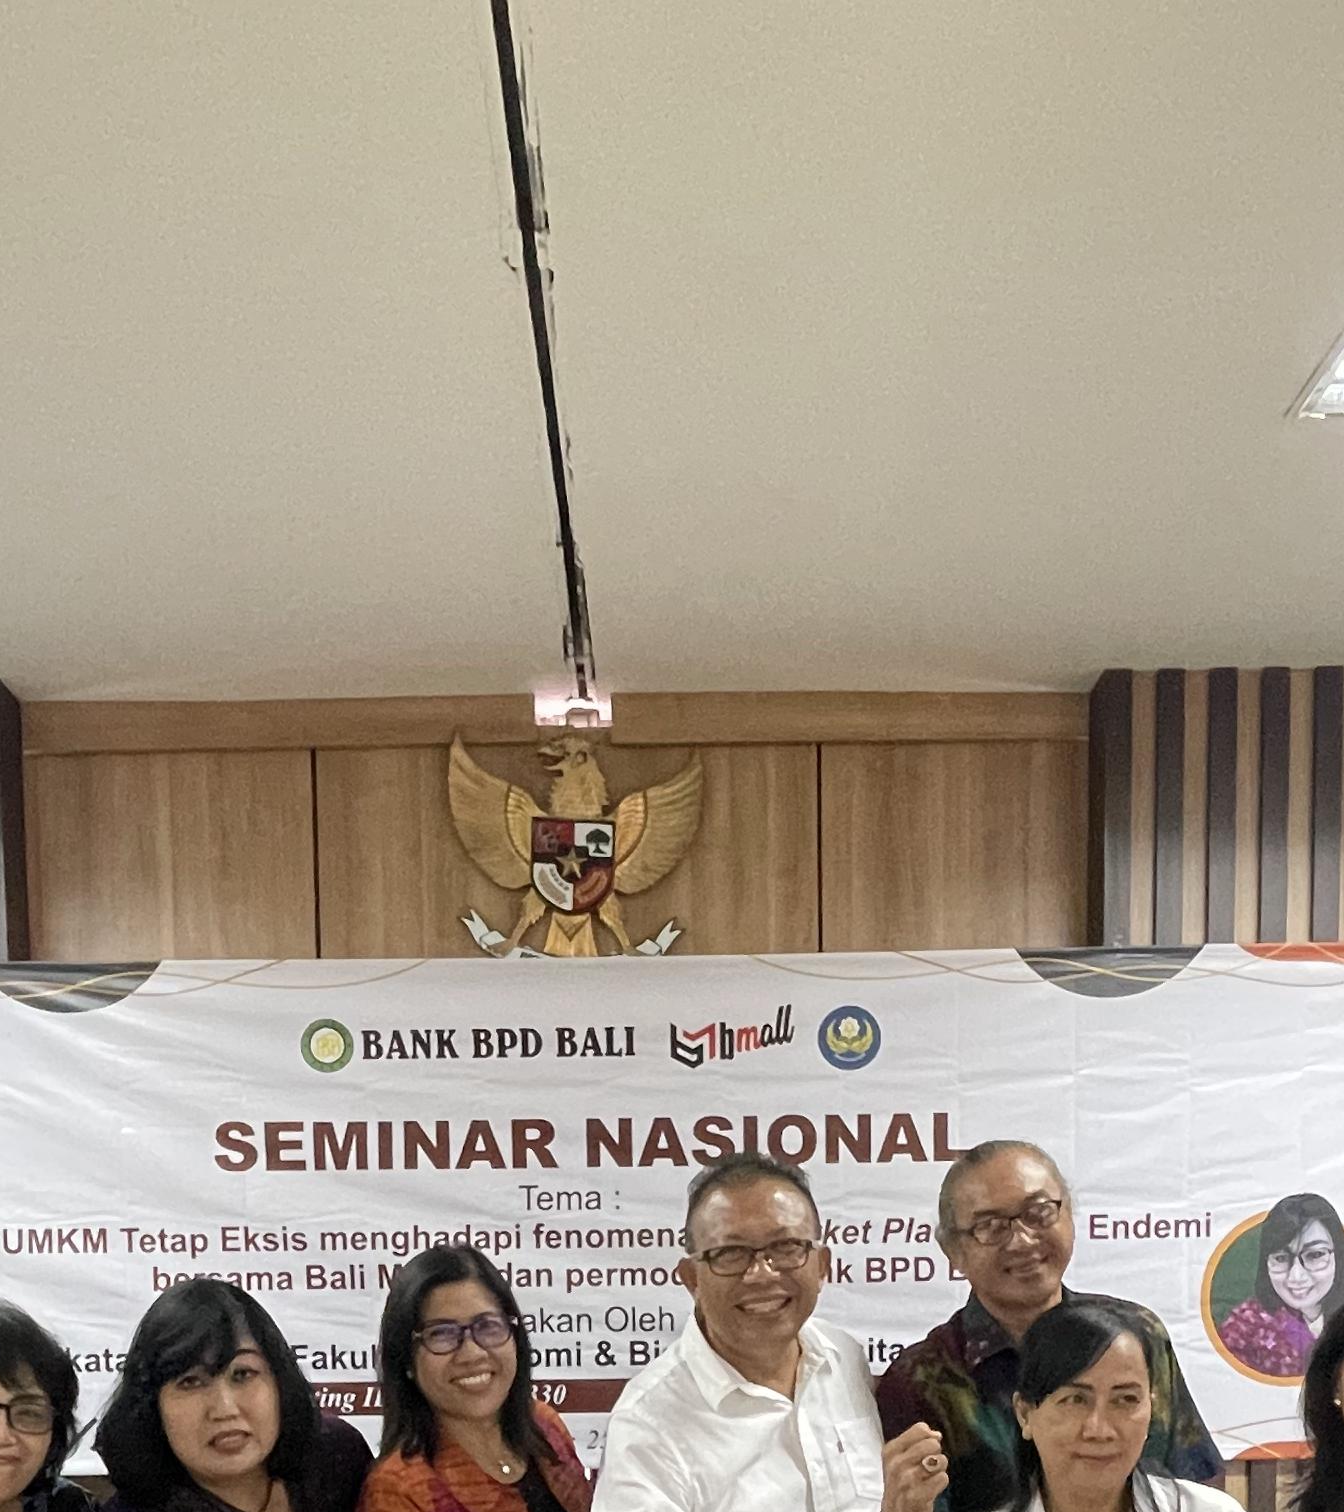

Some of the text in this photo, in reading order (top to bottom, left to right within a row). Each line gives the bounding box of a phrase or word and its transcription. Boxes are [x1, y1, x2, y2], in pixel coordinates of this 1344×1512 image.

[362, 1027, 636, 1060] BANK BPD BALI
[213, 1112, 970, 1171] SEMINAR NASIONAL
[519, 1185, 602, 1212] Tema
[2, 1228, 108, 1254] UMKM
[120, 1227, 208, 1259] Tetap
[221, 1226, 307, 1252] Eksis
[1088, 1212, 1212, 1240] Endemi
[306, 1264, 365, 1291] Bali
[866, 1256, 935, 1283] BPD
[604, 1305, 675, 1333] Oleh
[594, 1341, 617, 1366] &
